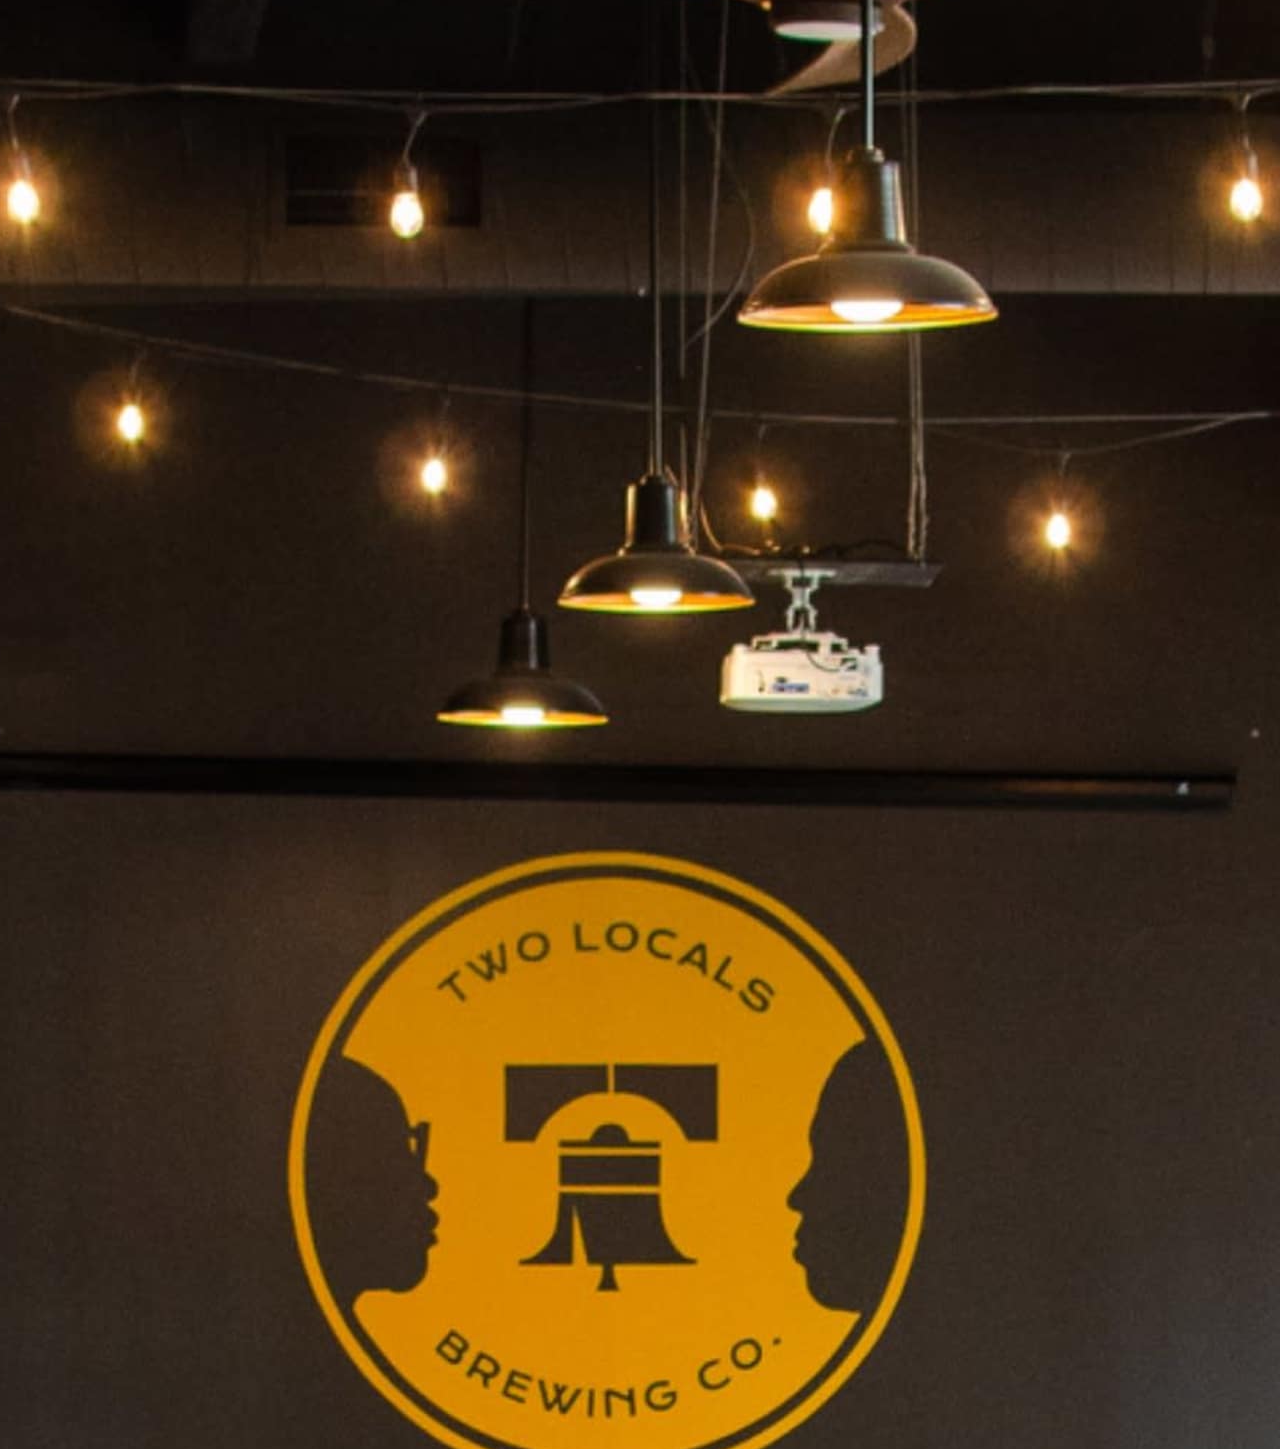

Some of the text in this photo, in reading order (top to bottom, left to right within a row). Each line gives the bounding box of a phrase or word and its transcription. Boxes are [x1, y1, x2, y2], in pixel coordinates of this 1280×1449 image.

[437, 921, 776, 1013] TWO LOCALS
[435, 1329, 782, 1418] BREWING CO.
